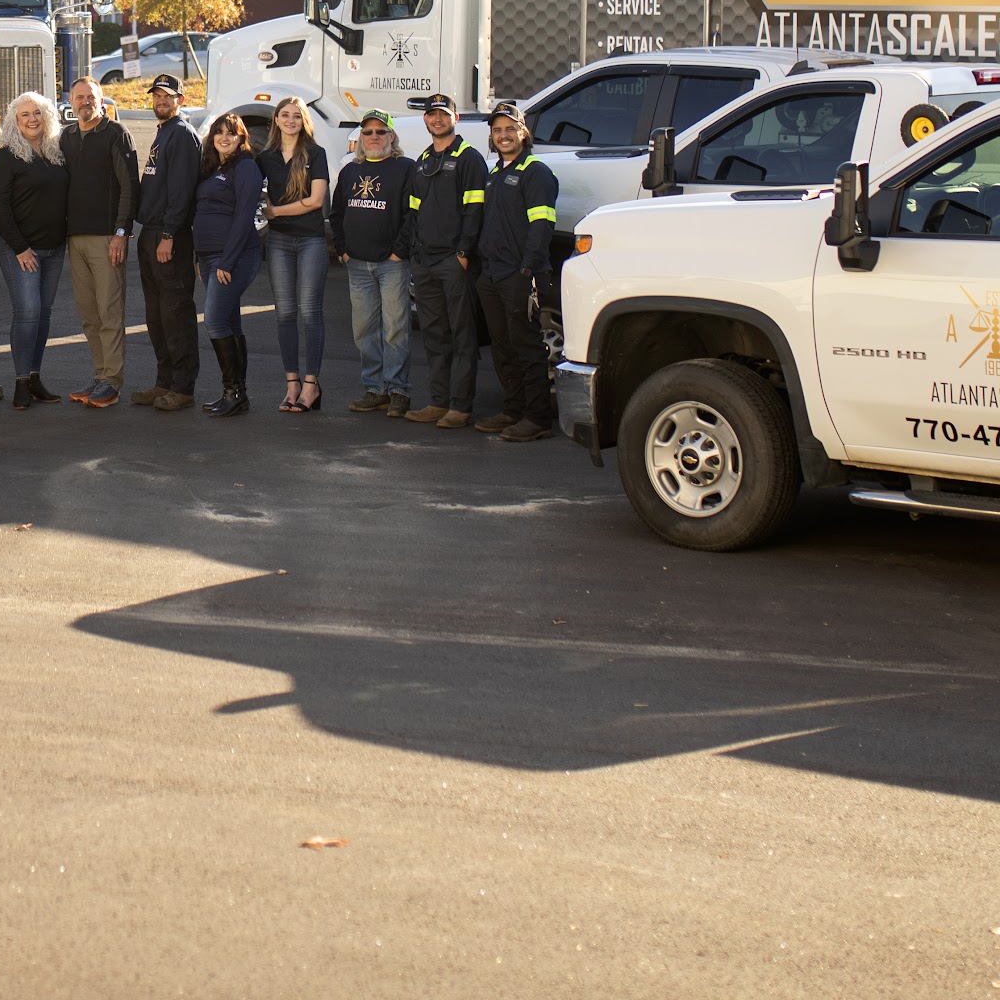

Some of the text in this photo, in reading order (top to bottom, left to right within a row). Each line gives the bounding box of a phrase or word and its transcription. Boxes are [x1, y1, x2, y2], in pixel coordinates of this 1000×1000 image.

[756, 11, 997, 58] ATLANTASCALE
[607, 35, 664, 55] RENTALS
[370, 77, 431, 91] ATLANTASCALES
[985, 290, 1000, 307] ES
[946, 313, 958, 343] A
[832, 346, 927, 361] 2500 HD
[931, 381, 1000, 408] ATLANTA
